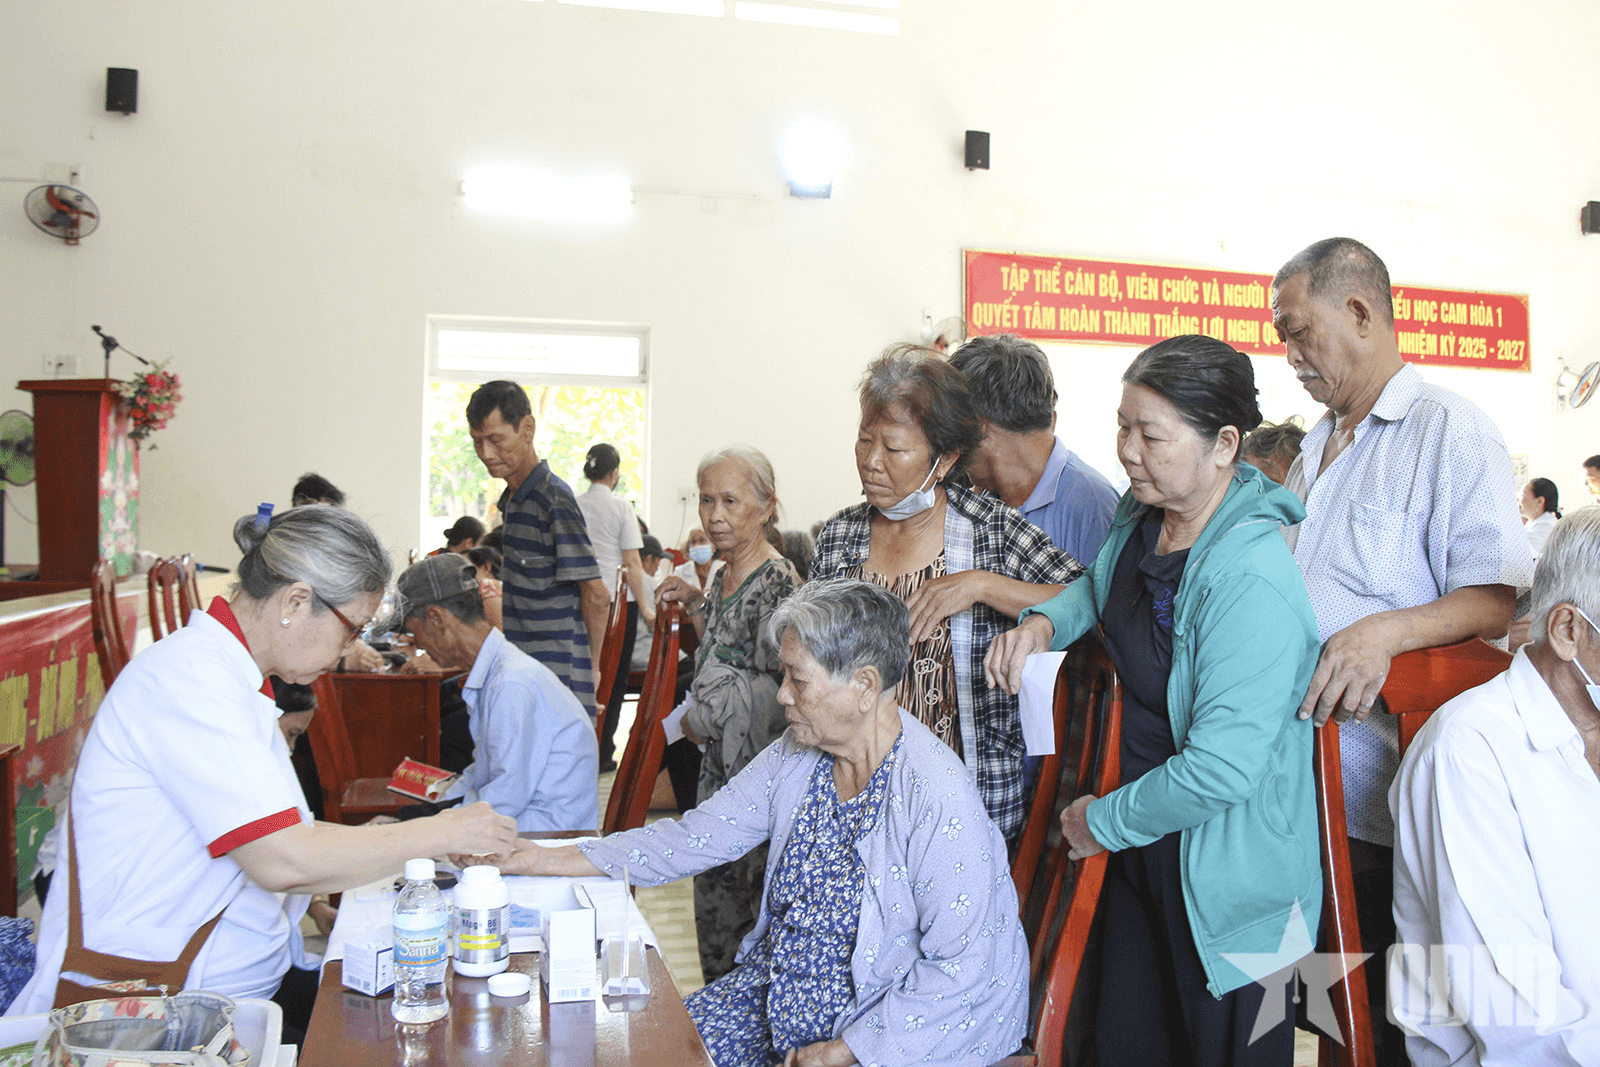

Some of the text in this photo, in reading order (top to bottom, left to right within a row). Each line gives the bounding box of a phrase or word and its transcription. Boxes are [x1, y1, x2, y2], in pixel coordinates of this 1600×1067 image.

[1001, 262, 1030, 297] TẬP
[1033, 261, 1062, 293] THỂ
[1064, 267, 1095, 297] CÁN
[1099, 269, 1123, 303] BỘ,
[1126, 272, 1159, 301] VIÊN
[1162, 275, 1199, 304] CHỨC
[1202, 278, 1221, 306] VÀ
[1223, 280, 1265, 309] NGƯỜI
[972, 296, 1020, 328] QUYẾT
[1023, 301, 1056, 331] TÂM
[1060, 304, 1100, 333] HOÀN
[1103, 306, 1151, 336] THÀNH
[1153, 307, 1200, 338] THẮNG
[1227, 318, 1260, 348] NGHỊ
[1413, 298, 1438, 327] HỌC
[1440, 300, 1467, 325] CAM
[1470, 300, 1494, 327] HÒA
[1496, 307, 1503, 328] 1
[1398, 329, 1437, 359] NHIỆM
[1440, 331, 1456, 357] KỲ
[1458, 337, 1487, 359] 2025
[1497, 339, 1525, 361] 2027
[399, 938, 440, 957] Sanna
